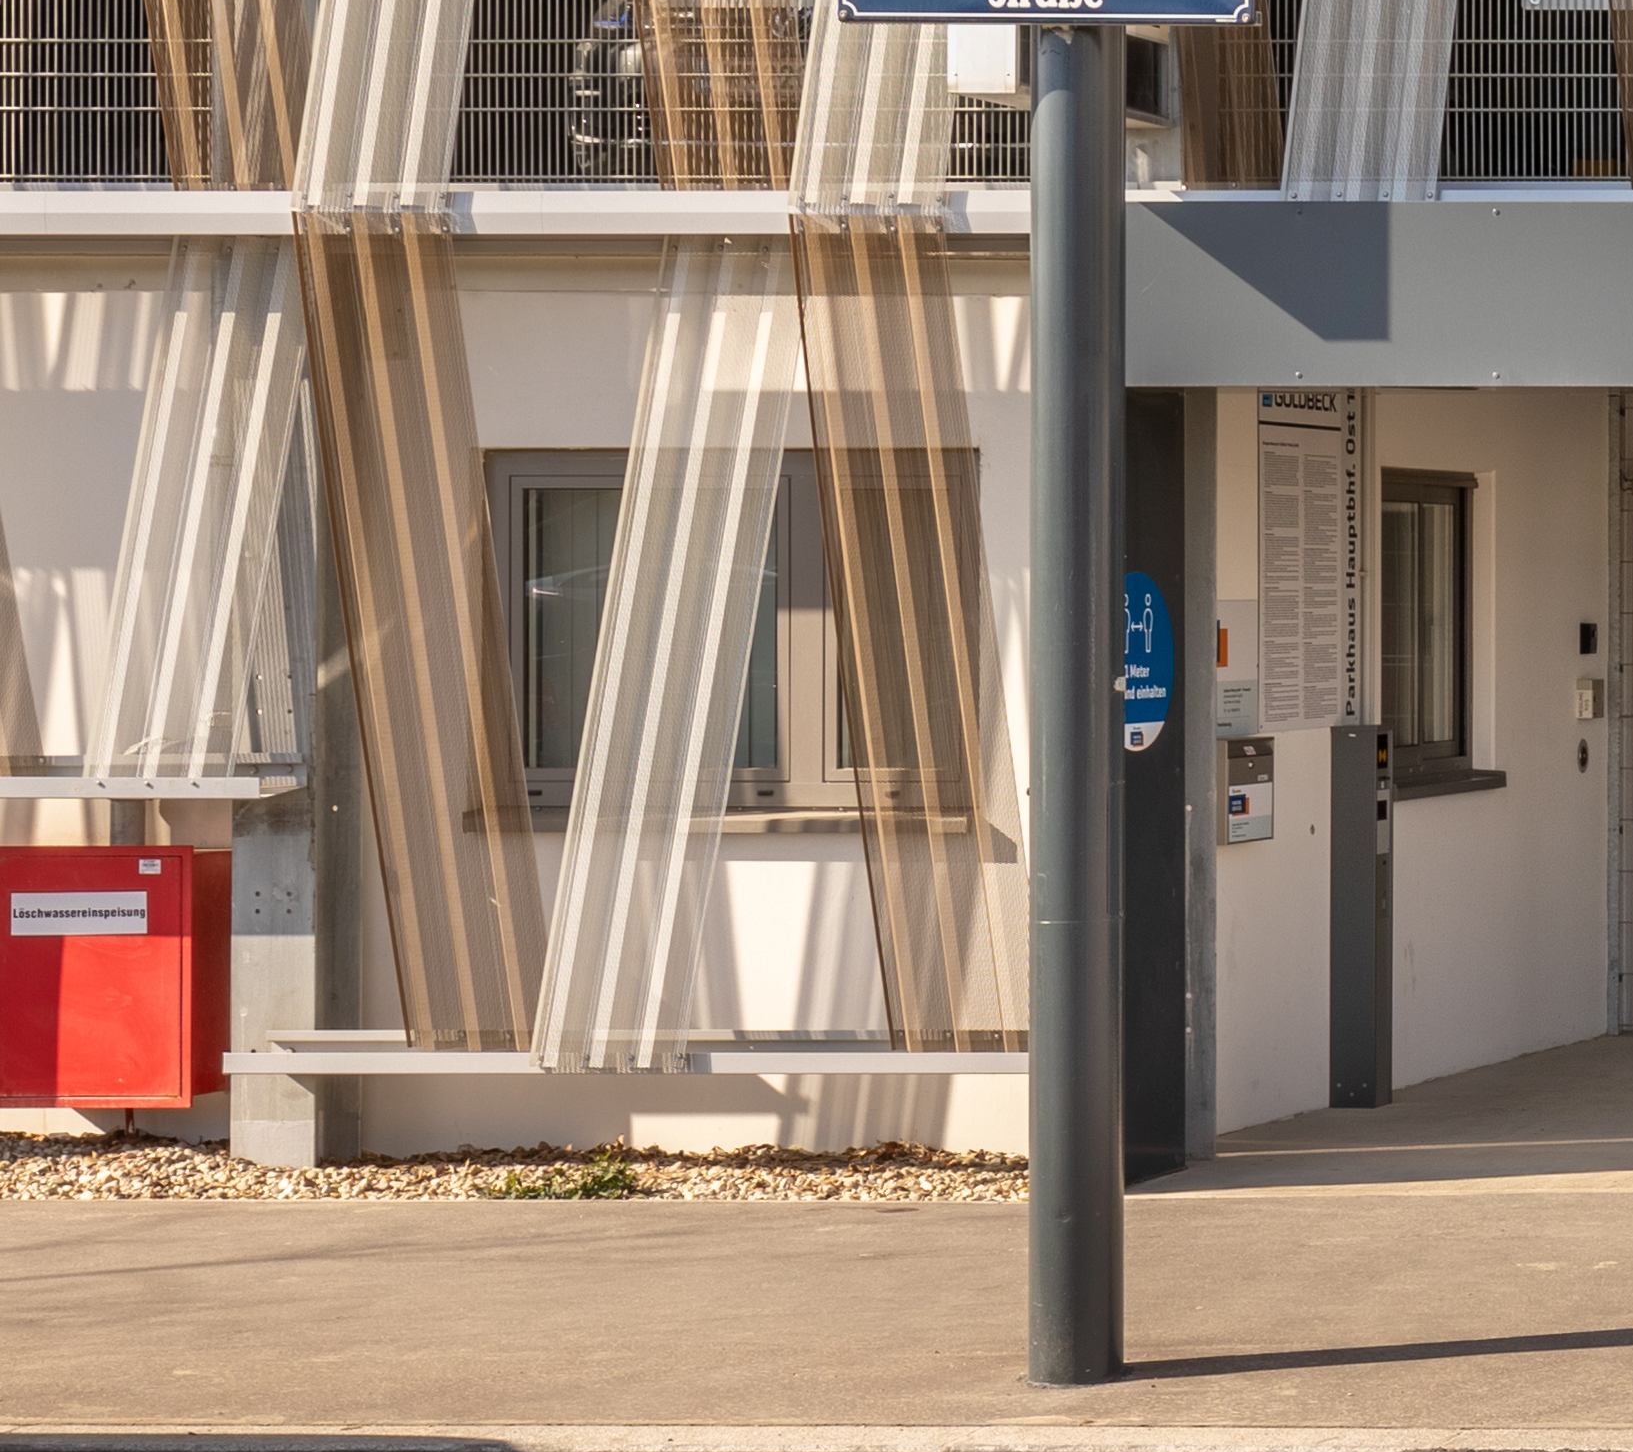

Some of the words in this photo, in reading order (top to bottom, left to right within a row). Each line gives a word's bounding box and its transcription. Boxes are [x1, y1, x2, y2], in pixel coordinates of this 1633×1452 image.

[1274, 393, 1337, 413] GOLDBECK
[1346, 411, 1356, 455] Ost
[1346, 600, 1356, 716] Parkhaus
[1130, 664, 1150, 678] Meter
[13, 907, 146, 920] Löschwassereinspeisung
